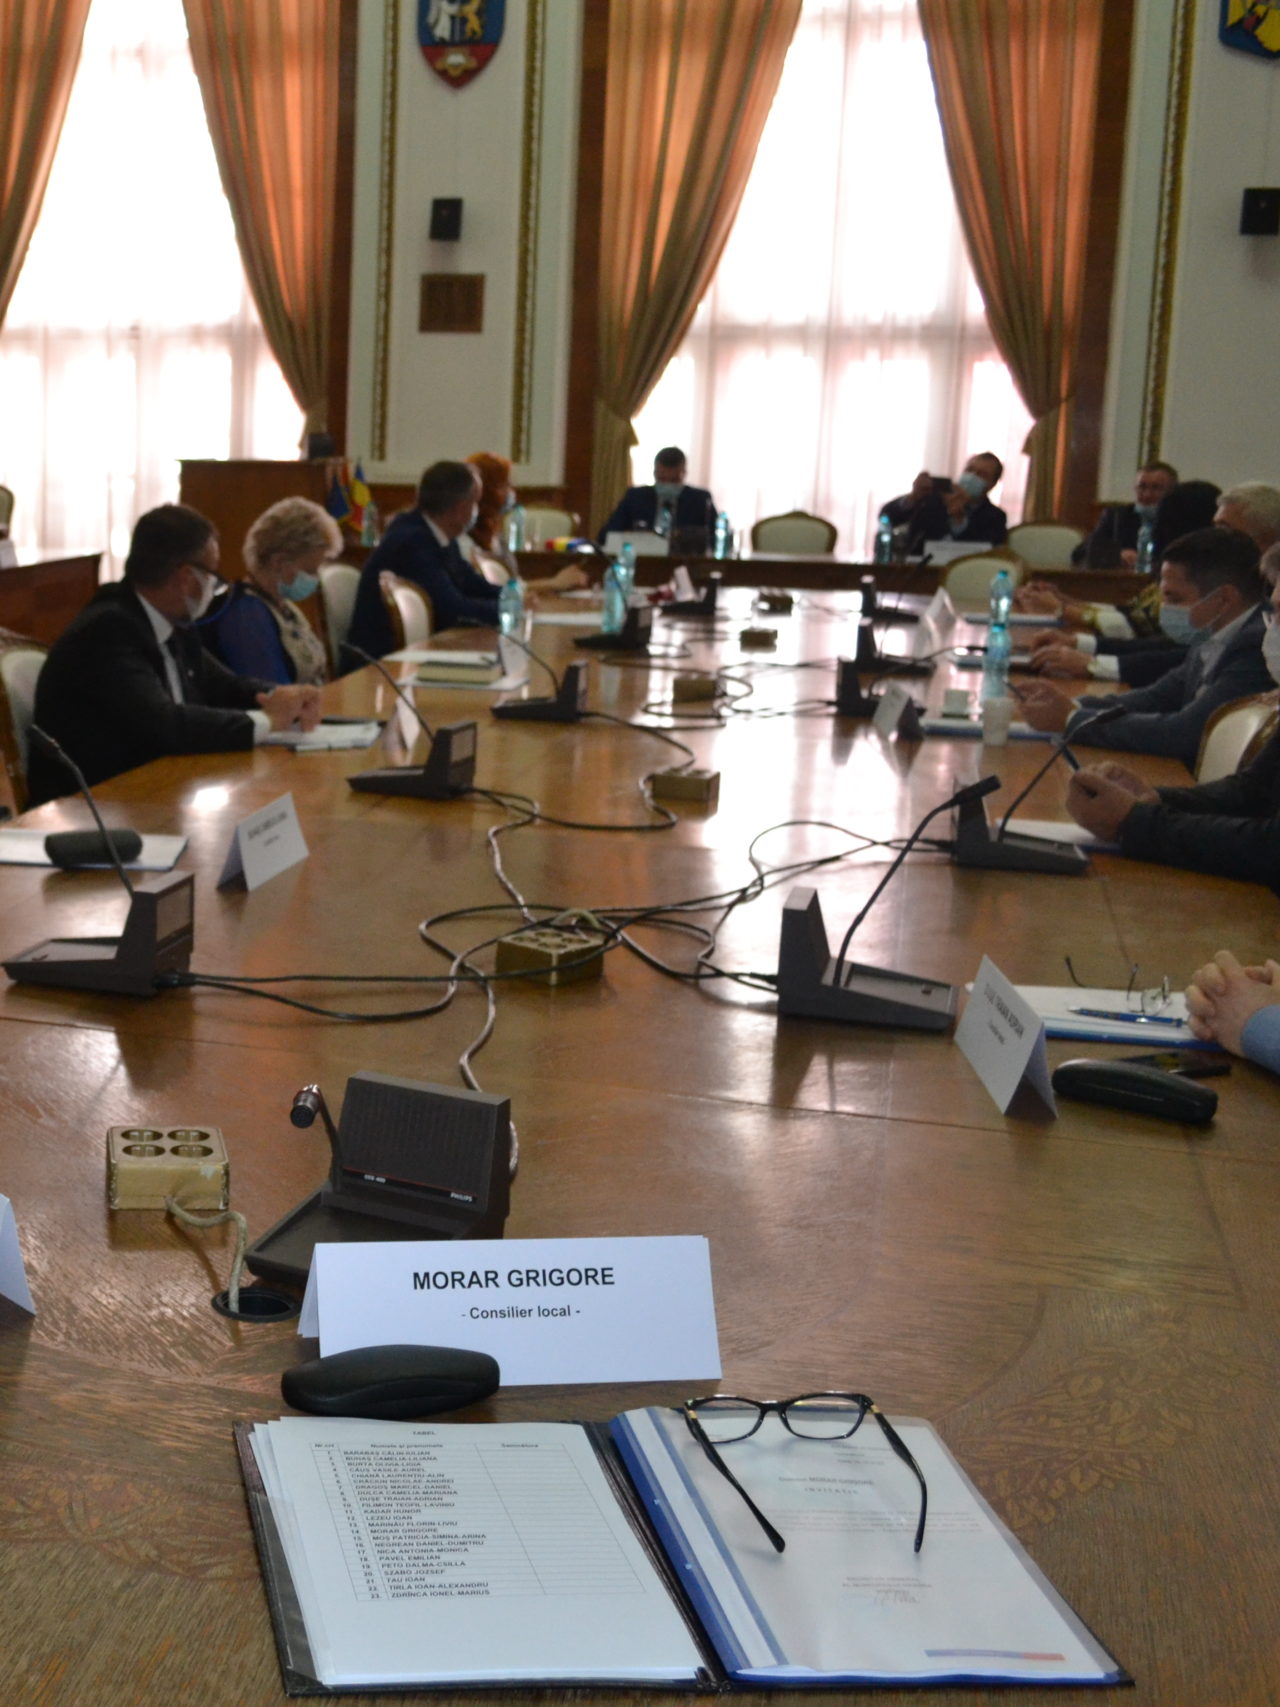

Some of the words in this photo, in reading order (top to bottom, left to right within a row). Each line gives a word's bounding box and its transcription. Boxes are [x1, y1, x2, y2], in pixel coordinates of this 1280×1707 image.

[450, 1192, 473, 1203] PHILIPS
[412, 1269, 500, 1290] MORAR
[507, 1266, 615, 1288] GRIGORE
[469, 1306, 532, 1320] Consilier
[538, 1304, 570, 1317] local
[414, 1582, 489, 1590] IOAN-ALEXANDRU
